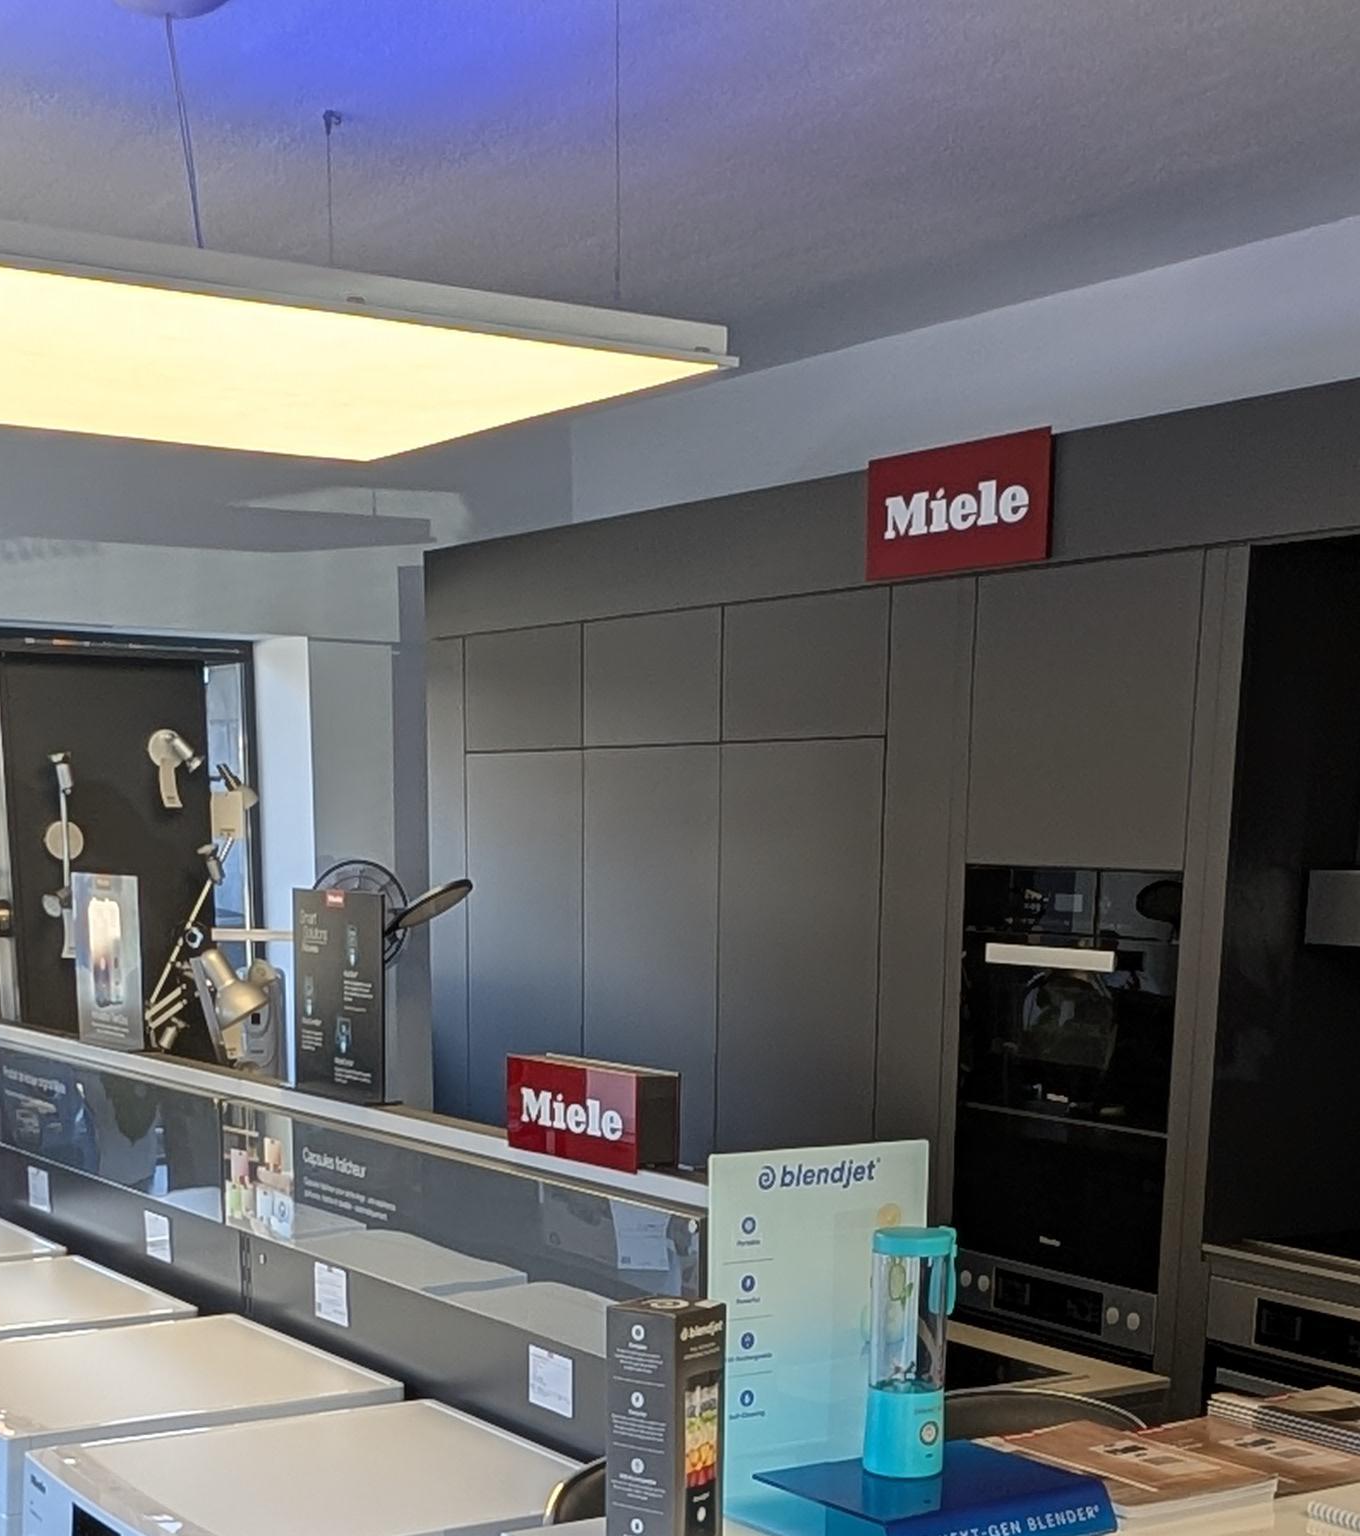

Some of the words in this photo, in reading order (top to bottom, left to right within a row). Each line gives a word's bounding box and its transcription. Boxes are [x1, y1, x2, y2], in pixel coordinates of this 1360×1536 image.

[884, 480, 1029, 539] Miele
[521, 1087, 623, 1140] Miele
[780, 1159, 875, 1189] blendjet
